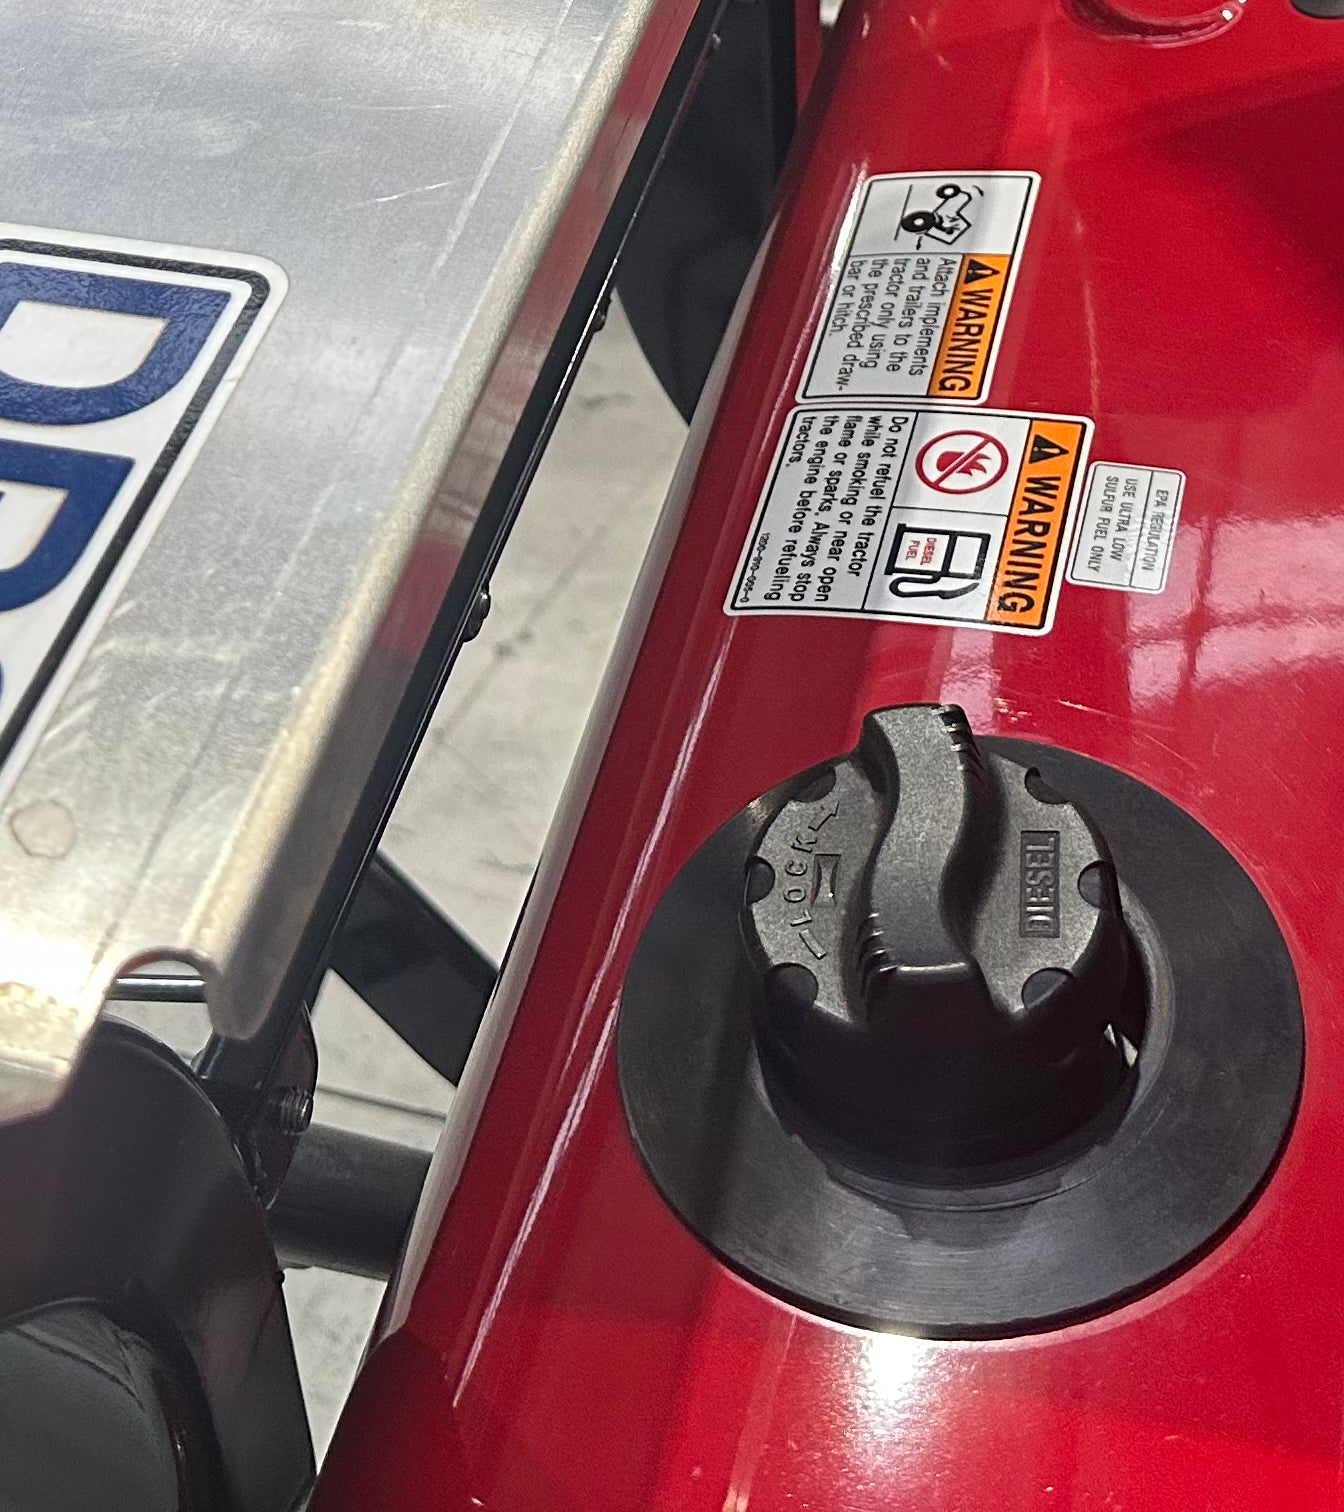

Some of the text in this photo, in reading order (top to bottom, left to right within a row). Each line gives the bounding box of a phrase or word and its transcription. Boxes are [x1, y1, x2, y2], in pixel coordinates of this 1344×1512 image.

[828, 259, 868, 337] bar or hitch.
[835, 259, 888, 391] the prescribed draw-
[859, 258, 911, 369] tractor only using
[886, 257, 931, 373] and trailers to the
[908, 257, 958, 377] Attach implements
[938, 289, 994, 392] WARNING
[785, 415, 818, 468] tractors.
[763, 415, 840, 601] the engine before refueling
[788, 415, 863, 602] flame or sparks. Always stop
[814, 415, 883, 602] while smoking or near open
[847, 416, 909, 577] Do not refuel the tractor
[997, 476, 1062, 614] WARNING
[1088, 475, 1119, 572] SULFUR FUEL ONLY
[1110, 478, 1138, 562] USE ULTRA LOW
[1141, 489, 1169, 572] EPA REGULATION
[905, 540, 921, 561] FUEL
[920, 537, 937, 566] DIESEL
[783, 832, 818, 928] LOCK
[1025, 835, 1055, 934] DIESEL
